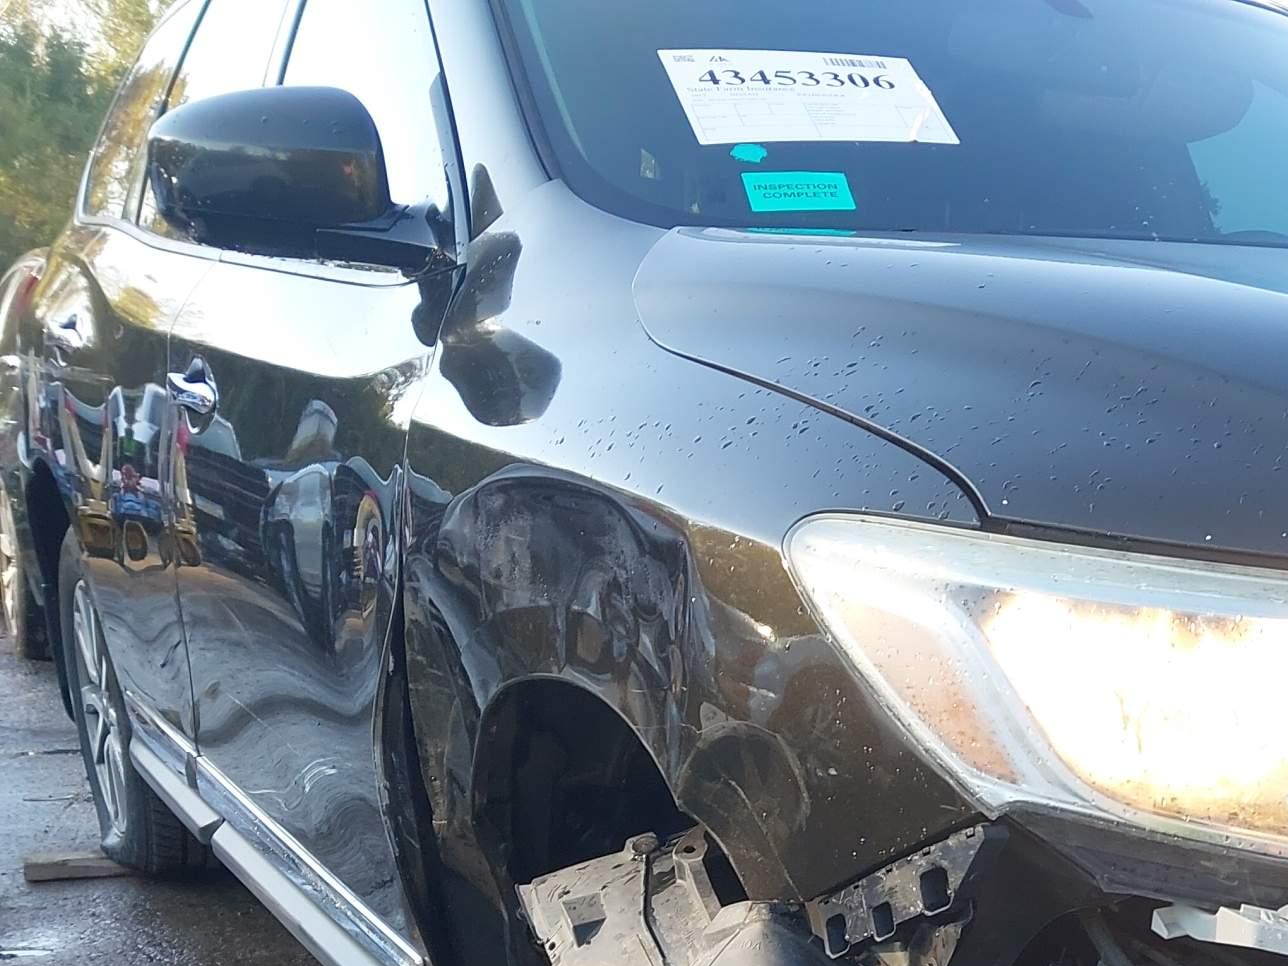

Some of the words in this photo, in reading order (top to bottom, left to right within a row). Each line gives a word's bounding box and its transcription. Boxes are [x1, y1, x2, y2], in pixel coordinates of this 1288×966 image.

[698, 69, 896, 90] 43453306
[753, 183, 838, 191] INSPECTION
[762, 191, 839, 199] COMPLETE
